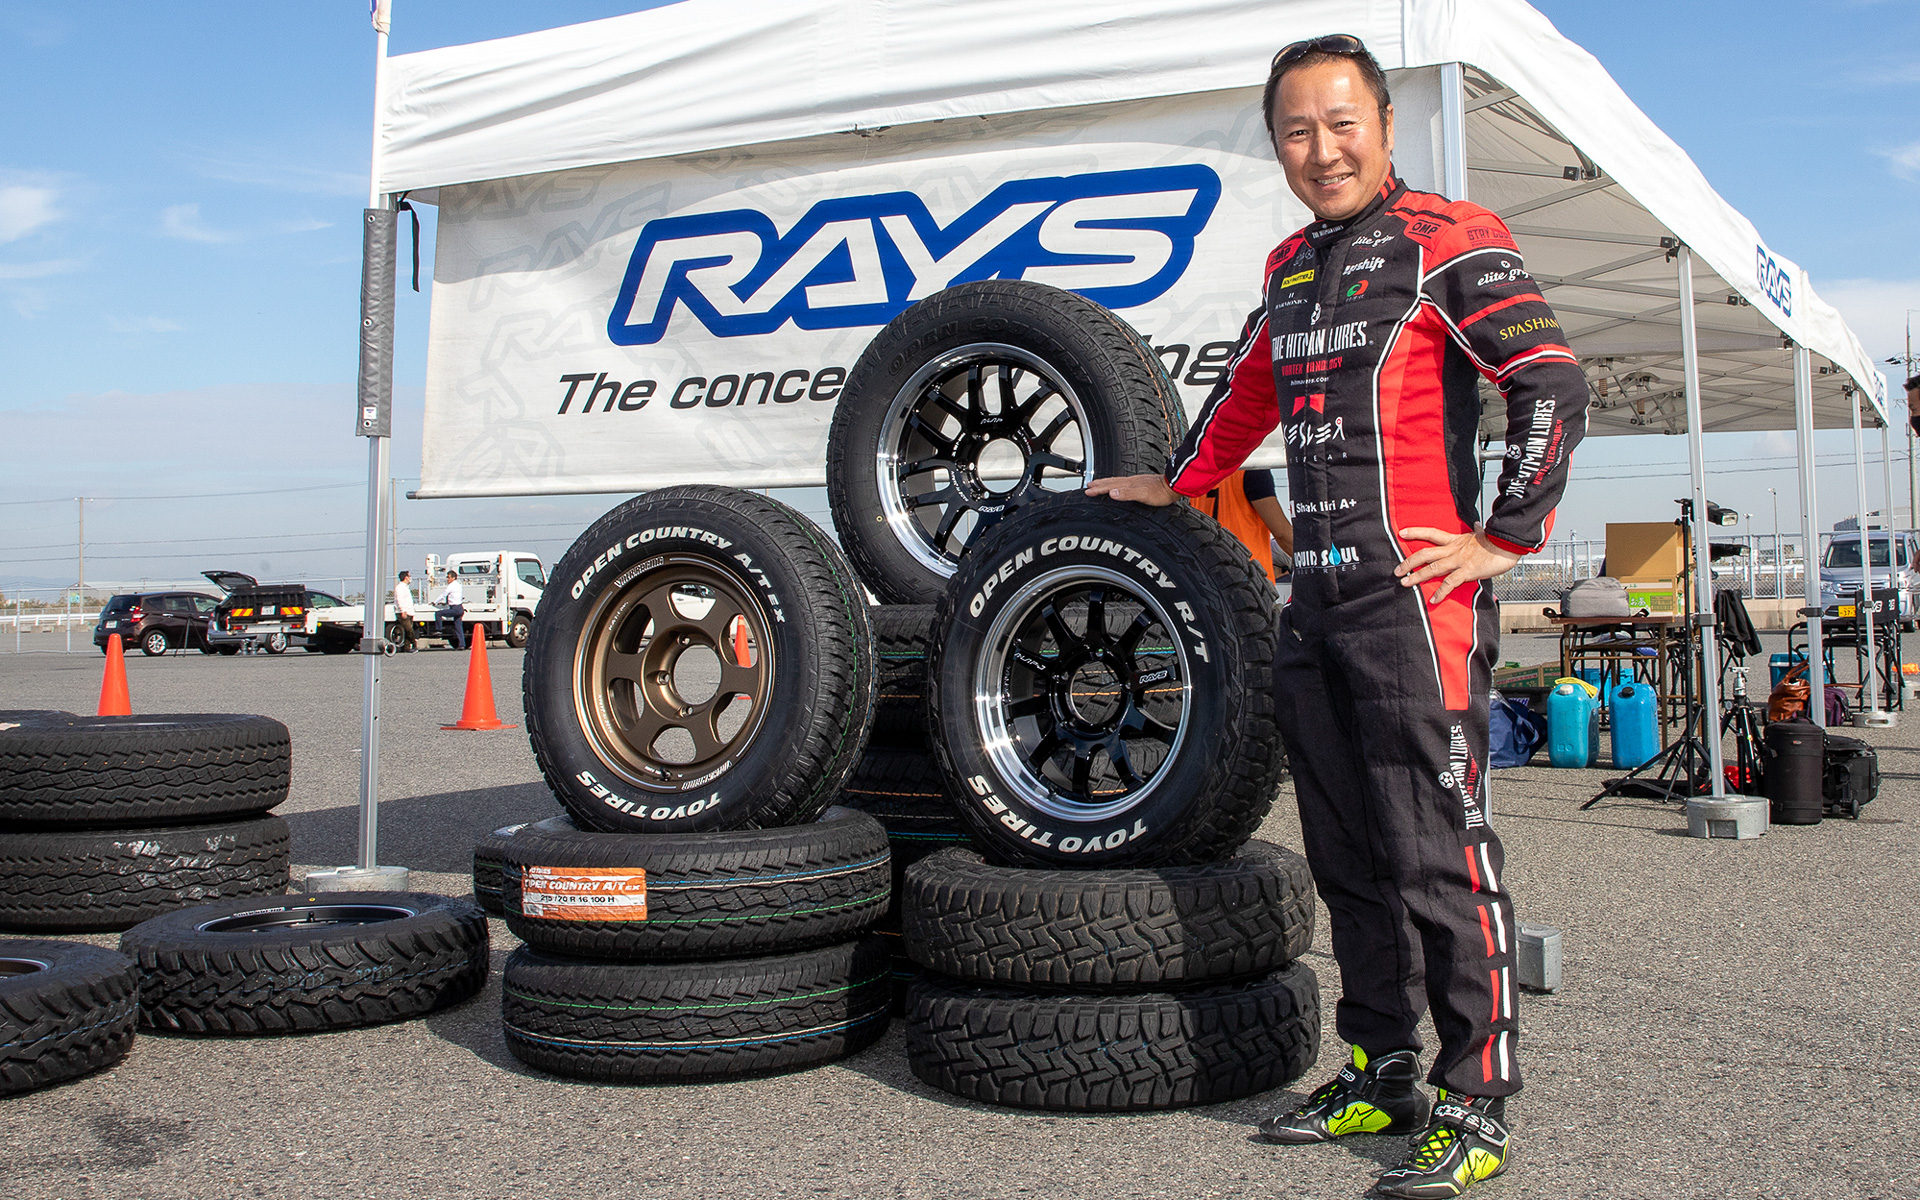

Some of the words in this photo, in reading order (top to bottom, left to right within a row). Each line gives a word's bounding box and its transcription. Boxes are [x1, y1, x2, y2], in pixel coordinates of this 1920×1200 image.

[1412, 222, 1438, 234] OMP
[607, 163, 1222, 346] RAYS
[1477, 271, 1508, 286] elite
[1756, 244, 1792, 318] RAYS
[1327, 320, 1368, 354] LURES
[1499, 317, 1560, 341] SPASHAN
[557, 372, 657, 415] The
[1529, 399, 1556, 436] LURES
[1340, 498, 1357, 510] A+
[571, 542, 622, 601] OPEN
[625, 526, 733, 550] COUNTRY
[969, 547, 1034, 618] OPEN
[1040, 535, 1177, 590] COUNTRY
[1173, 600, 1210, 664] R/T
[1138, 669, 1168, 685] RAYS
[1449, 723, 1469, 760] LURES
[576, 769, 648, 819] TIRES
[650, 792, 721, 821] TOYO
[967, 774, 1052, 848] TIRES
[1464, 806, 1485, 830] THE
[1058, 818, 1148, 854] TOYO
[548, 880, 601, 891] COUNTRY
[569, 894, 576, 904] R
[578, 895, 589, 904] 16
[591, 895, 605, 904] 100
[607, 895, 615, 904] H
